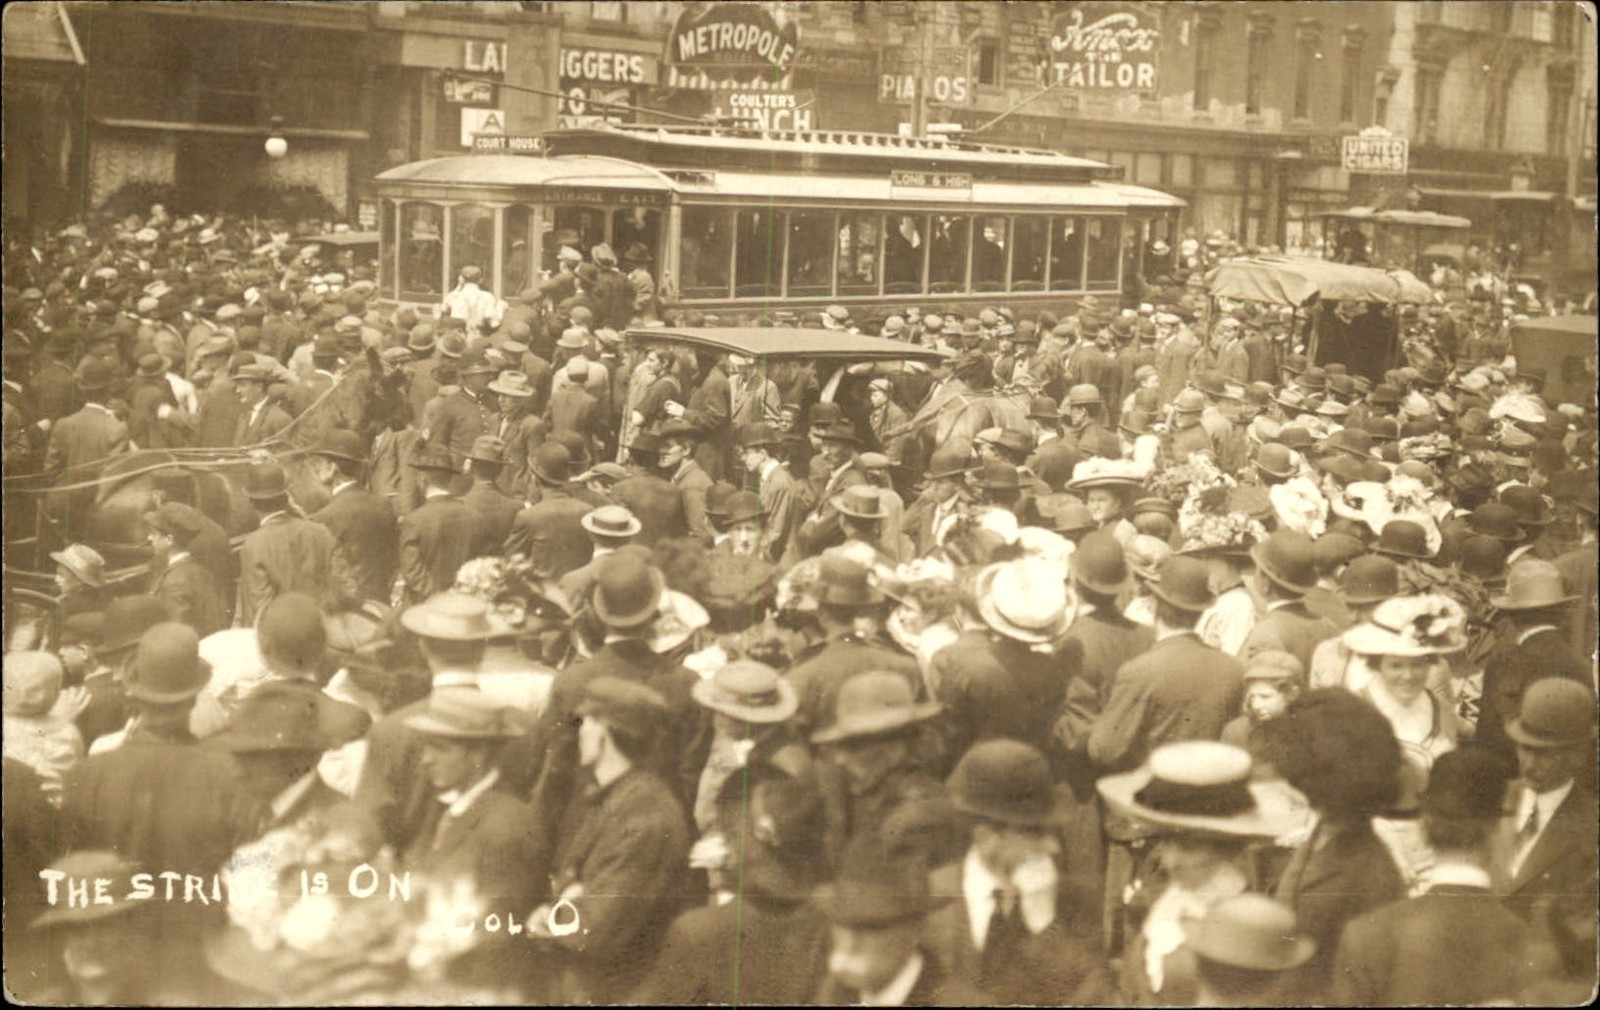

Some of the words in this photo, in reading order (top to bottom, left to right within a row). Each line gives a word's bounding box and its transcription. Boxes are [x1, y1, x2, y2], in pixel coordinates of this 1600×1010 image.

[678, 22, 794, 70] METROPOLE
[1054, 62, 1155, 88] TAILOR
[882, 74, 968, 101] PIAOS
[476, 137, 506, 149] COURT
[509, 137, 541, 150] HOUSE
[1348, 141, 1403, 155] UNITED
[1347, 155, 1402, 170] CIGARS
[895, 174, 926, 186] LONG
[932, 176, 941, 187] &
[945, 176, 969, 188] HIGH
